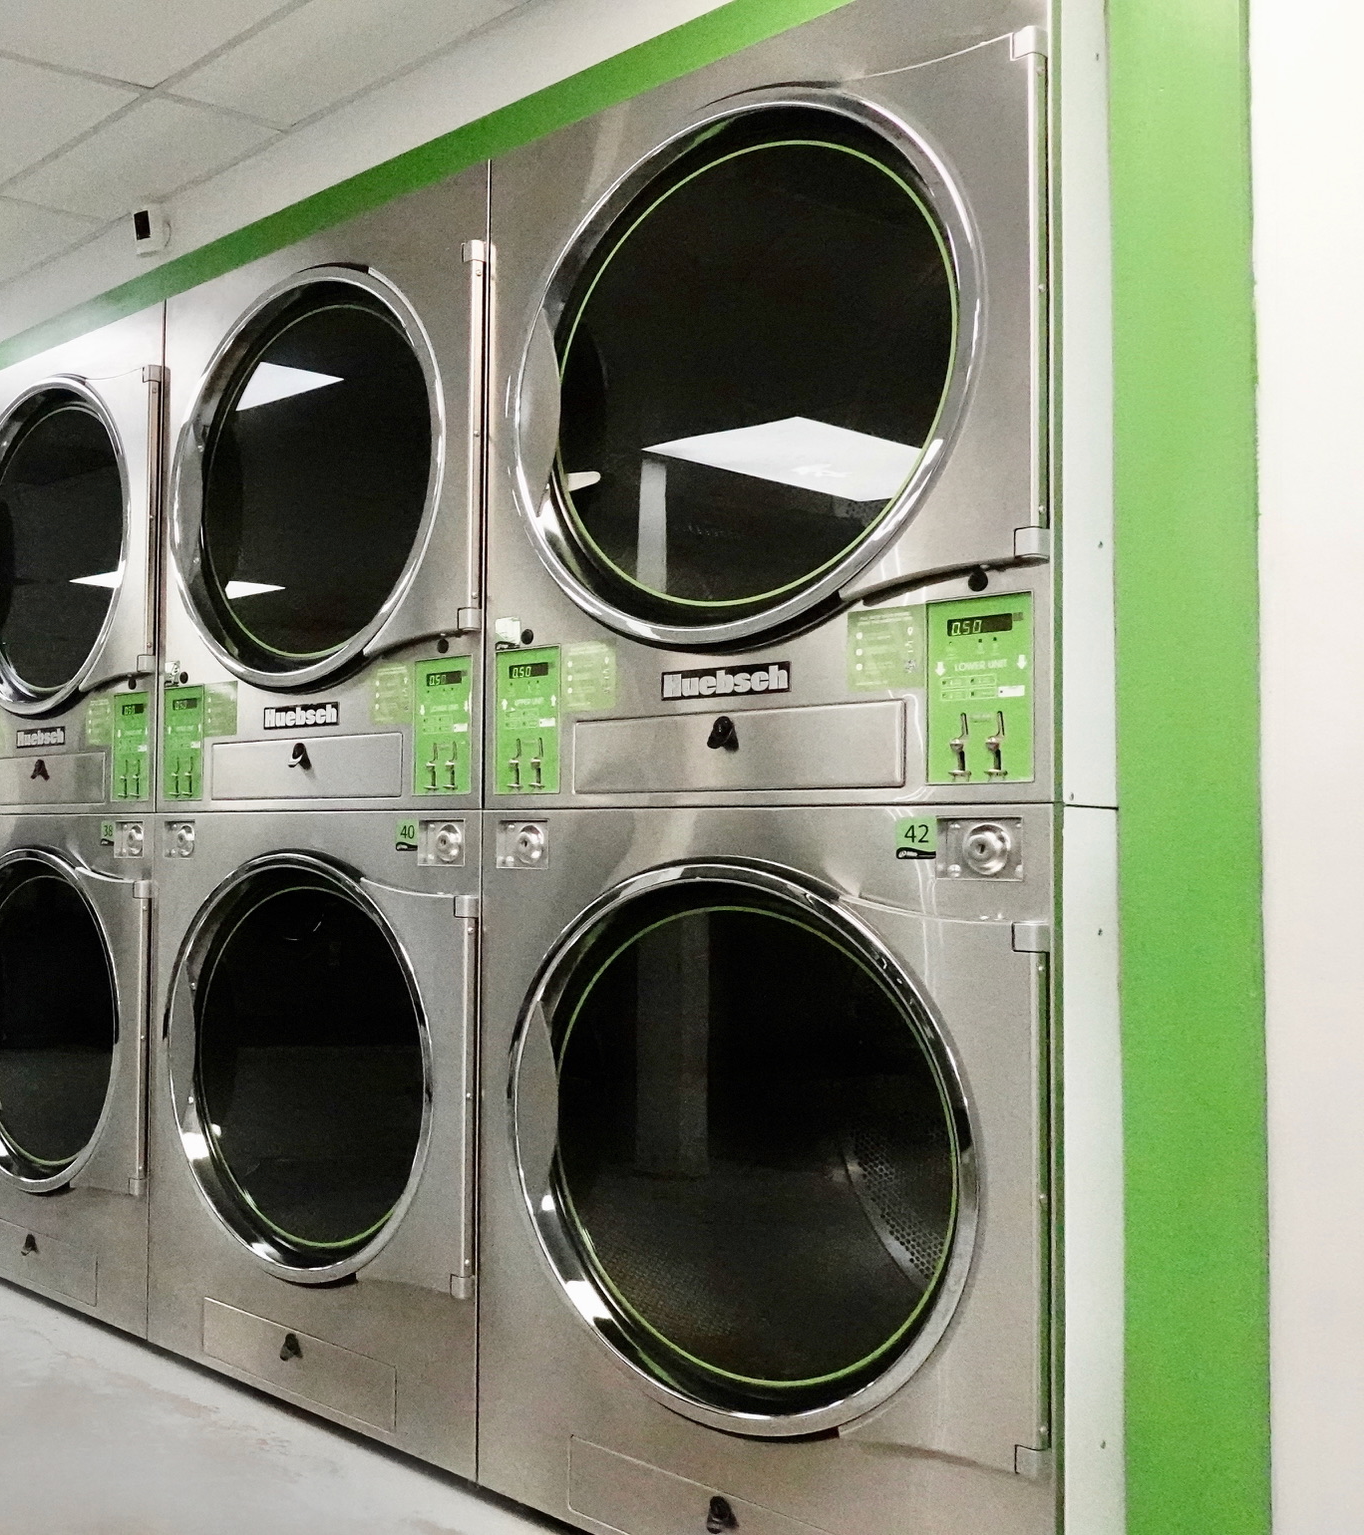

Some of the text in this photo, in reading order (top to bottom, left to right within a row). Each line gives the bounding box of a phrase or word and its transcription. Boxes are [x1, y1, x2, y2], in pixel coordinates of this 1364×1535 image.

[954, 661, 986, 672] LOWER
[663, 665, 788, 698] Huebsch
[264, 704, 338, 728] Huebsch
[103, 825, 113, 836] 38
[400, 825, 415, 839] 40
[904, 824, 929, 843] 42
